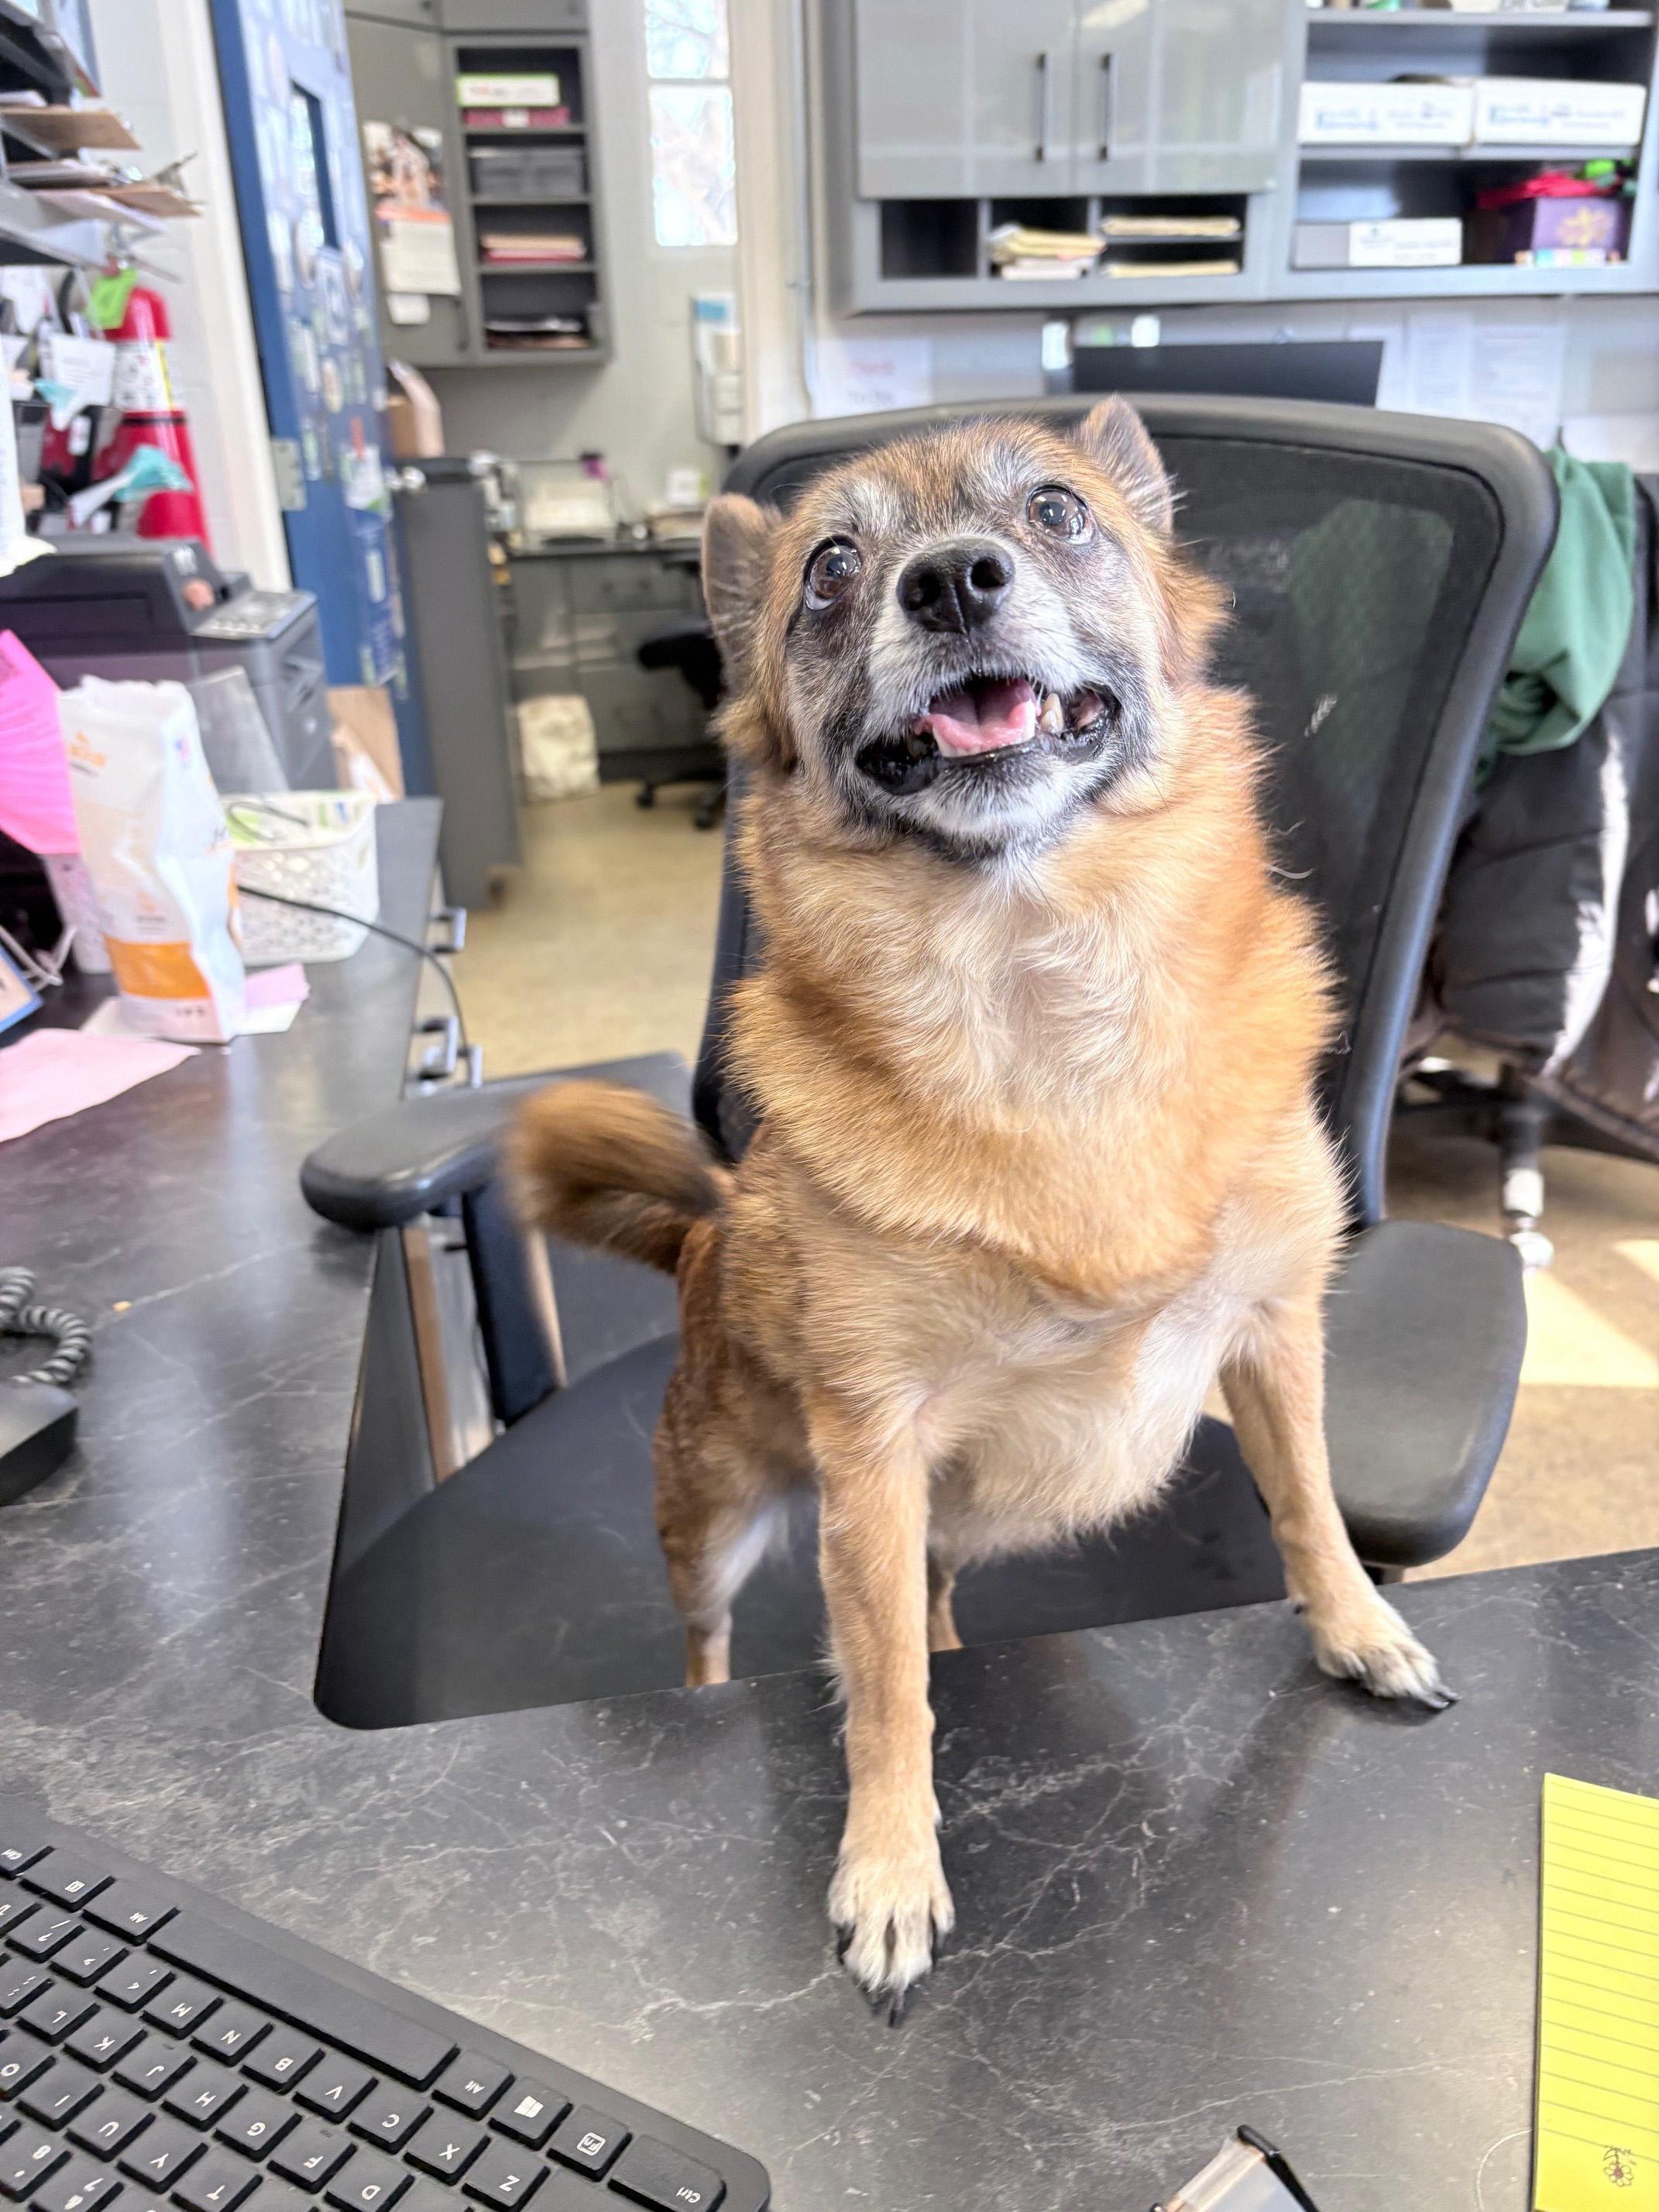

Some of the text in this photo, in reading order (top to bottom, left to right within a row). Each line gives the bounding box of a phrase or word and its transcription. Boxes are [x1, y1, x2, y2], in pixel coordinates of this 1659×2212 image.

[52, 2011, 67, 2024] L
[170, 2002, 193, 2018] M
[94, 2036, 115, 2051] K
[220, 2029, 242, 2045] N
[146, 2065, 165, 2076] J
[274, 2057, 294, 2072] B
[194, 2091, 217, 2107] H
[325, 2086, 343, 2100] V
[381, 2114, 400, 2128] C
[98, 2121, 119, 2138] U
[246, 2122, 266, 2137] G
[438, 2143, 461, 2161] X
[149, 2152, 170, 2169] Y
[303, 2155, 324, 2169] F
[499, 2175, 520, 2192] Z
[206, 2185, 225, 2200] T
[361, 2185, 381, 2200] D
[675, 2186, 701, 2203] Ctrl
